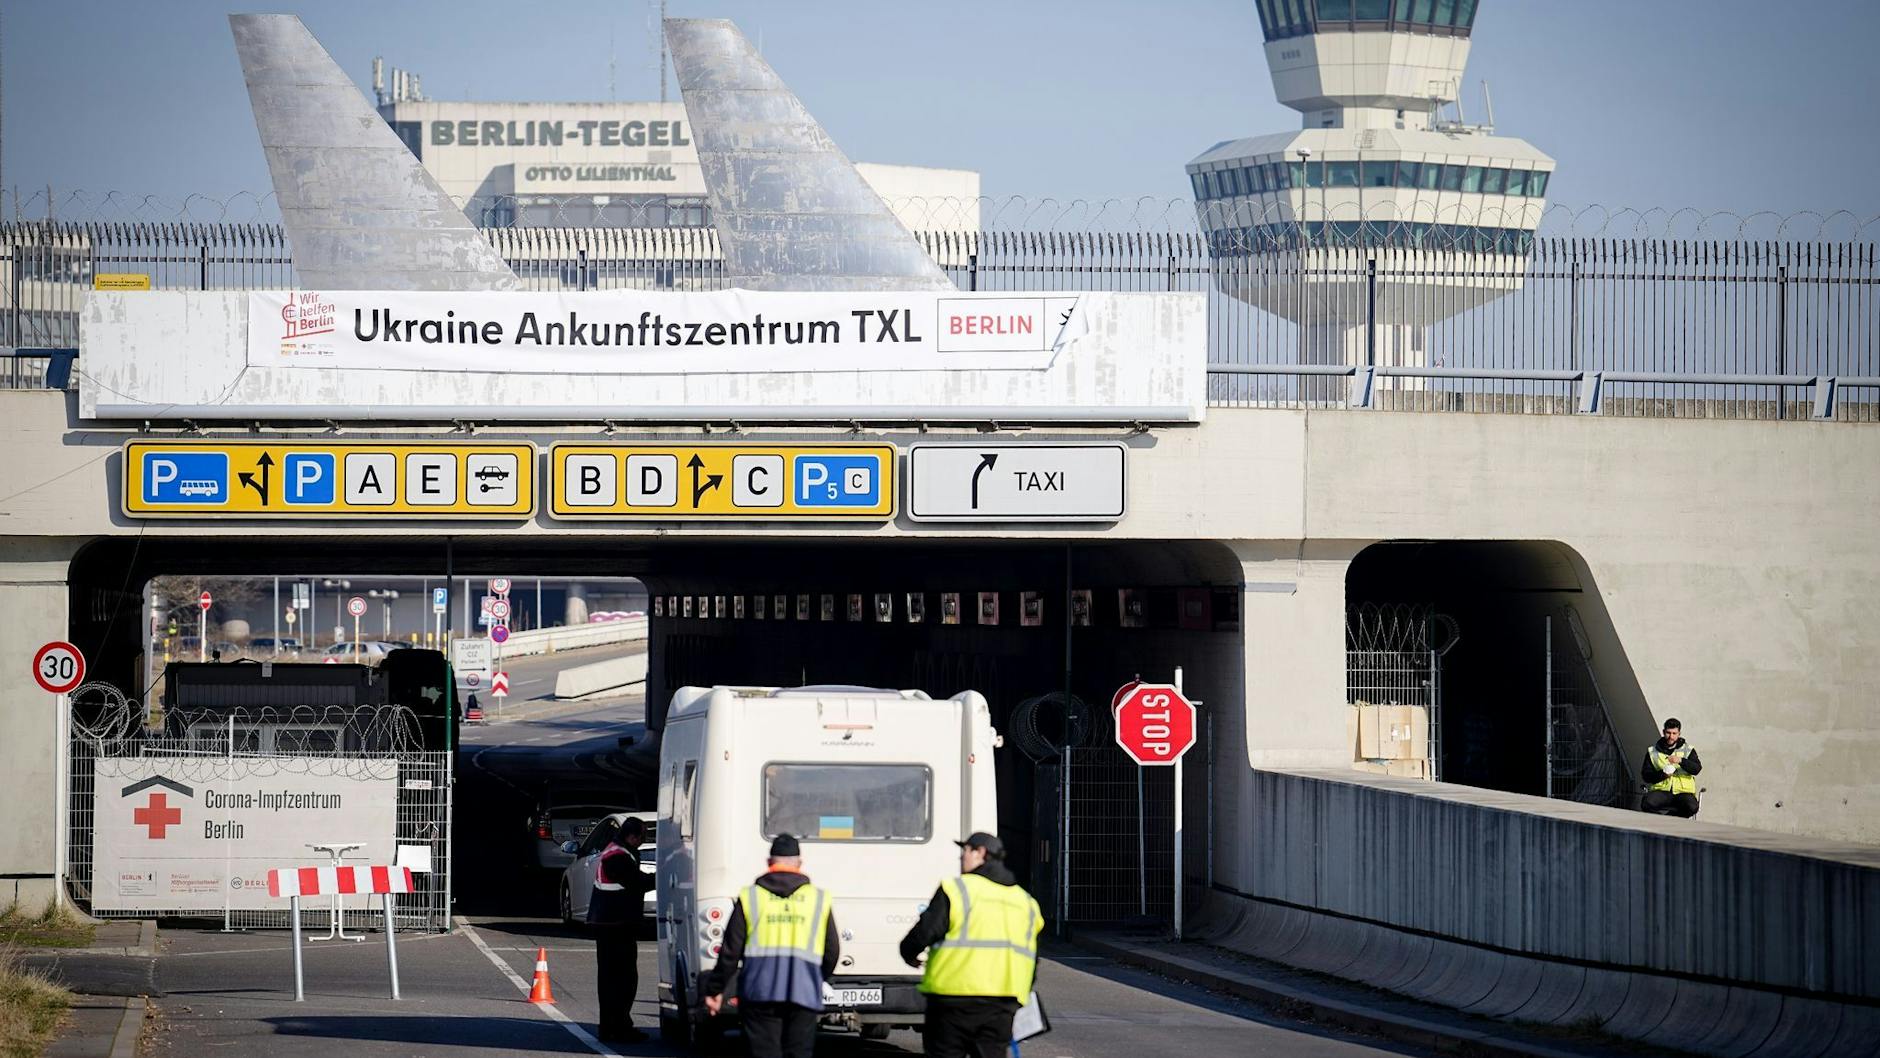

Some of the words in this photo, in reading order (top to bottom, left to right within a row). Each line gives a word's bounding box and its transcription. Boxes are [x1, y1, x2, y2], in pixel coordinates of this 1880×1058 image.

[431, 120, 690, 147] BERLIN-TEGEL
[525, 166, 573, 181] OTTO
[576, 166, 676, 181] LILIENTHAL
[300, 292, 320, 305] Wir
[300, 303, 336, 317] helfen
[300, 315, 334, 330] Berlin
[354, 308, 503, 343] Ukraine
[514, 311, 840, 346] Ankunftszentrum
[852, 308, 922, 343] TXL
[950, 315, 1032, 334] BERLIN
[151, 459, 178, 497] P
[296, 460, 322, 497] P
[358, 464, 383, 494] A
[422, 465, 441, 494] E
[580, 465, 601, 495] B
[641, 466, 663, 495] D
[748, 466, 769, 496] C
[852, 473, 863, 489] C
[1013, 471, 1065, 492] TAXI
[436, 590, 444, 603] P
[495, 604, 505, 613] 30
[44, 655, 74, 680] 30
[1141, 694, 1171, 756] STOP
[205, 789, 341, 812] Corona-Impfzentrum
[204, 820, 244, 839] Berlin
[842, 990, 857, 1002] RD
[860, 990, 880, 1002] 666
